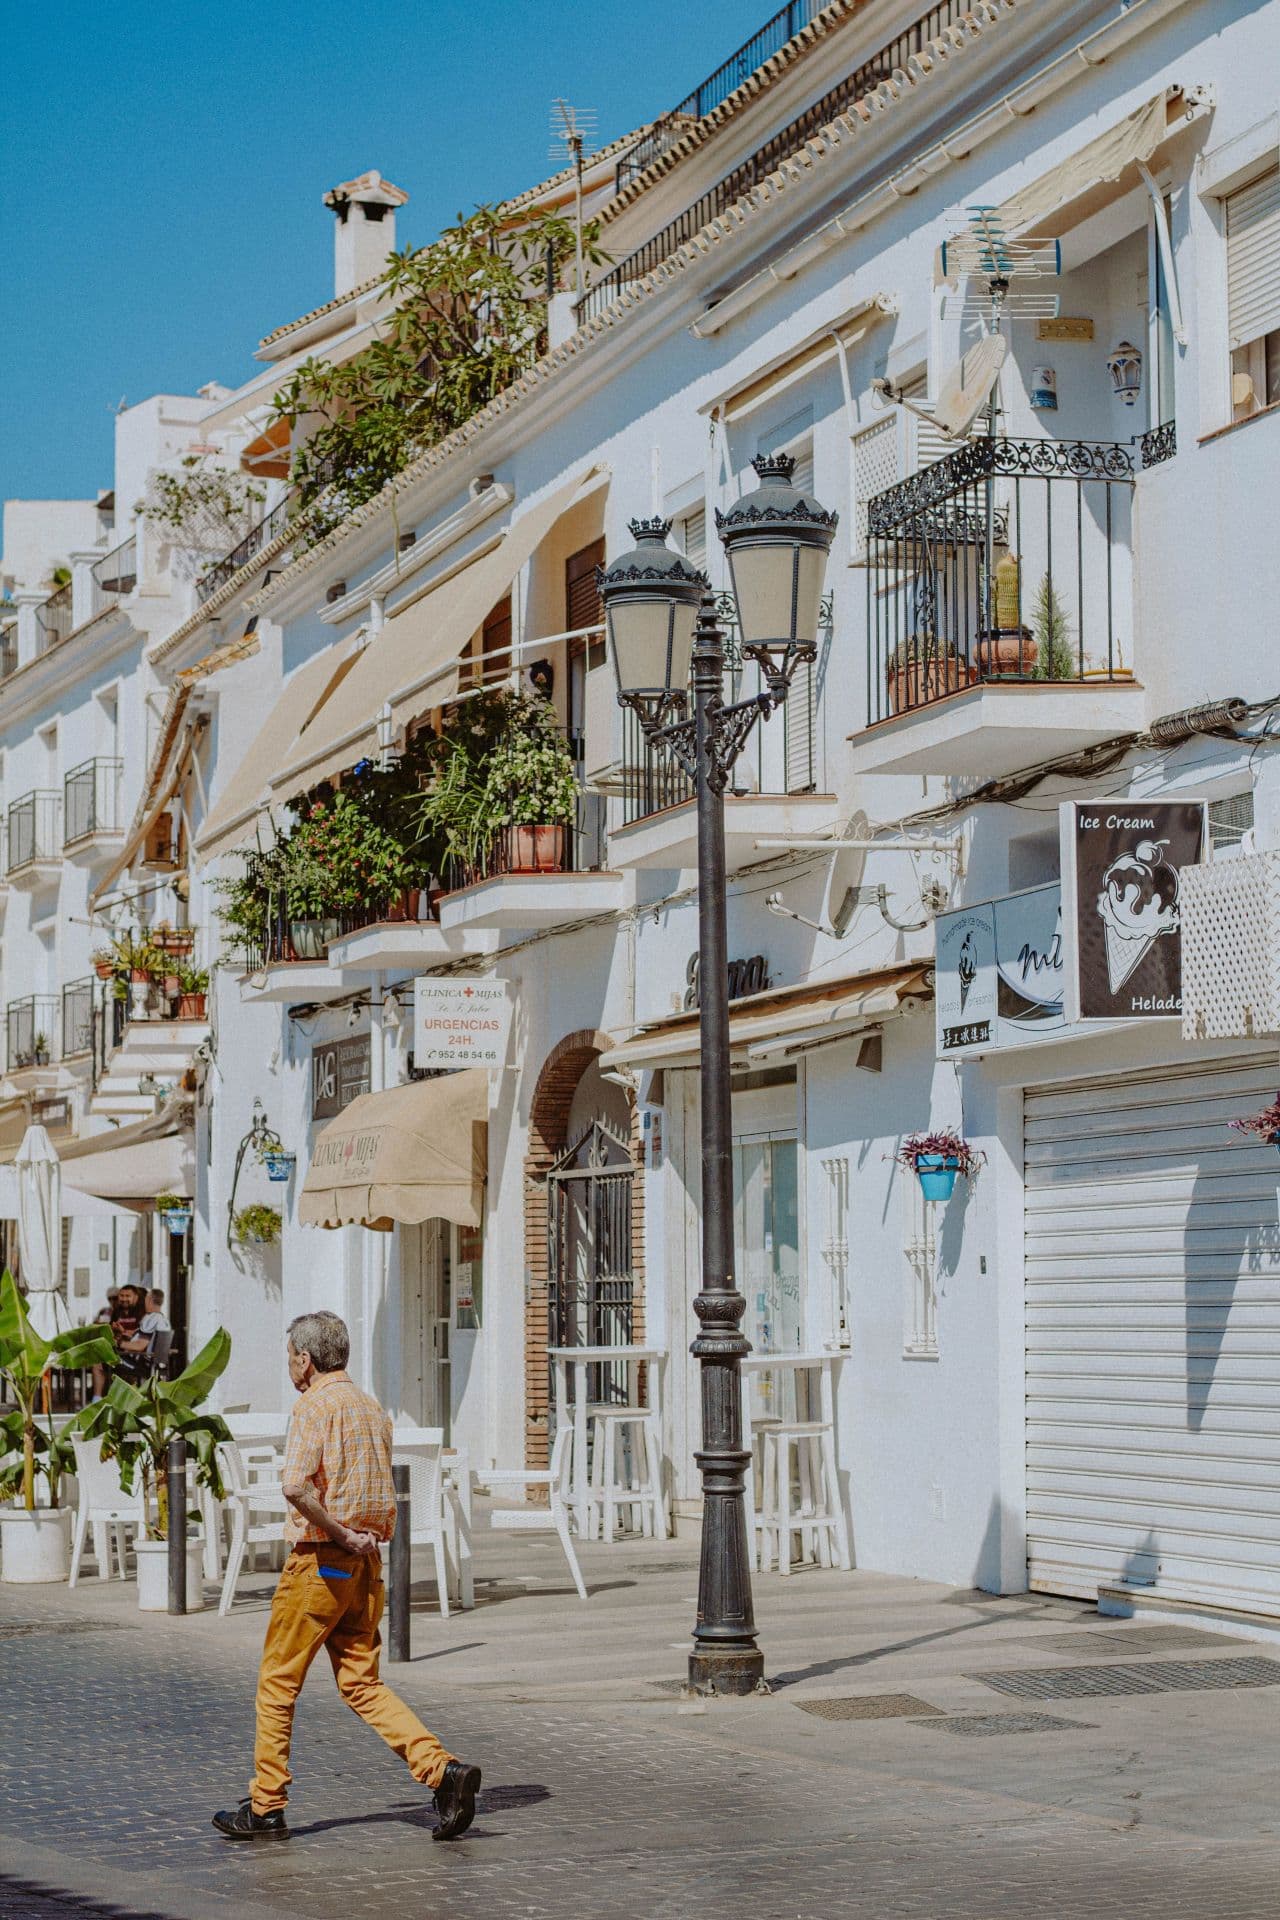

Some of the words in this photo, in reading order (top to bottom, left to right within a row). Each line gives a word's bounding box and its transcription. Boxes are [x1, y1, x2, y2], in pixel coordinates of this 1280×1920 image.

[1079, 814, 1101, 830] Ice
[1105, 814, 1155, 830] Cream
[420, 988, 462, 999] CLINICA
[475, 989, 504, 1000] MIJAS
[424, 1018, 500, 1031] URGENCIAS
[448, 1034, 475, 1046] 24H.
[438, 1050, 455, 1060] 952
[457, 1050, 469, 1060] 48
[471, 1051, 482, 1060] 54
[485, 1051, 497, 1060] 66
